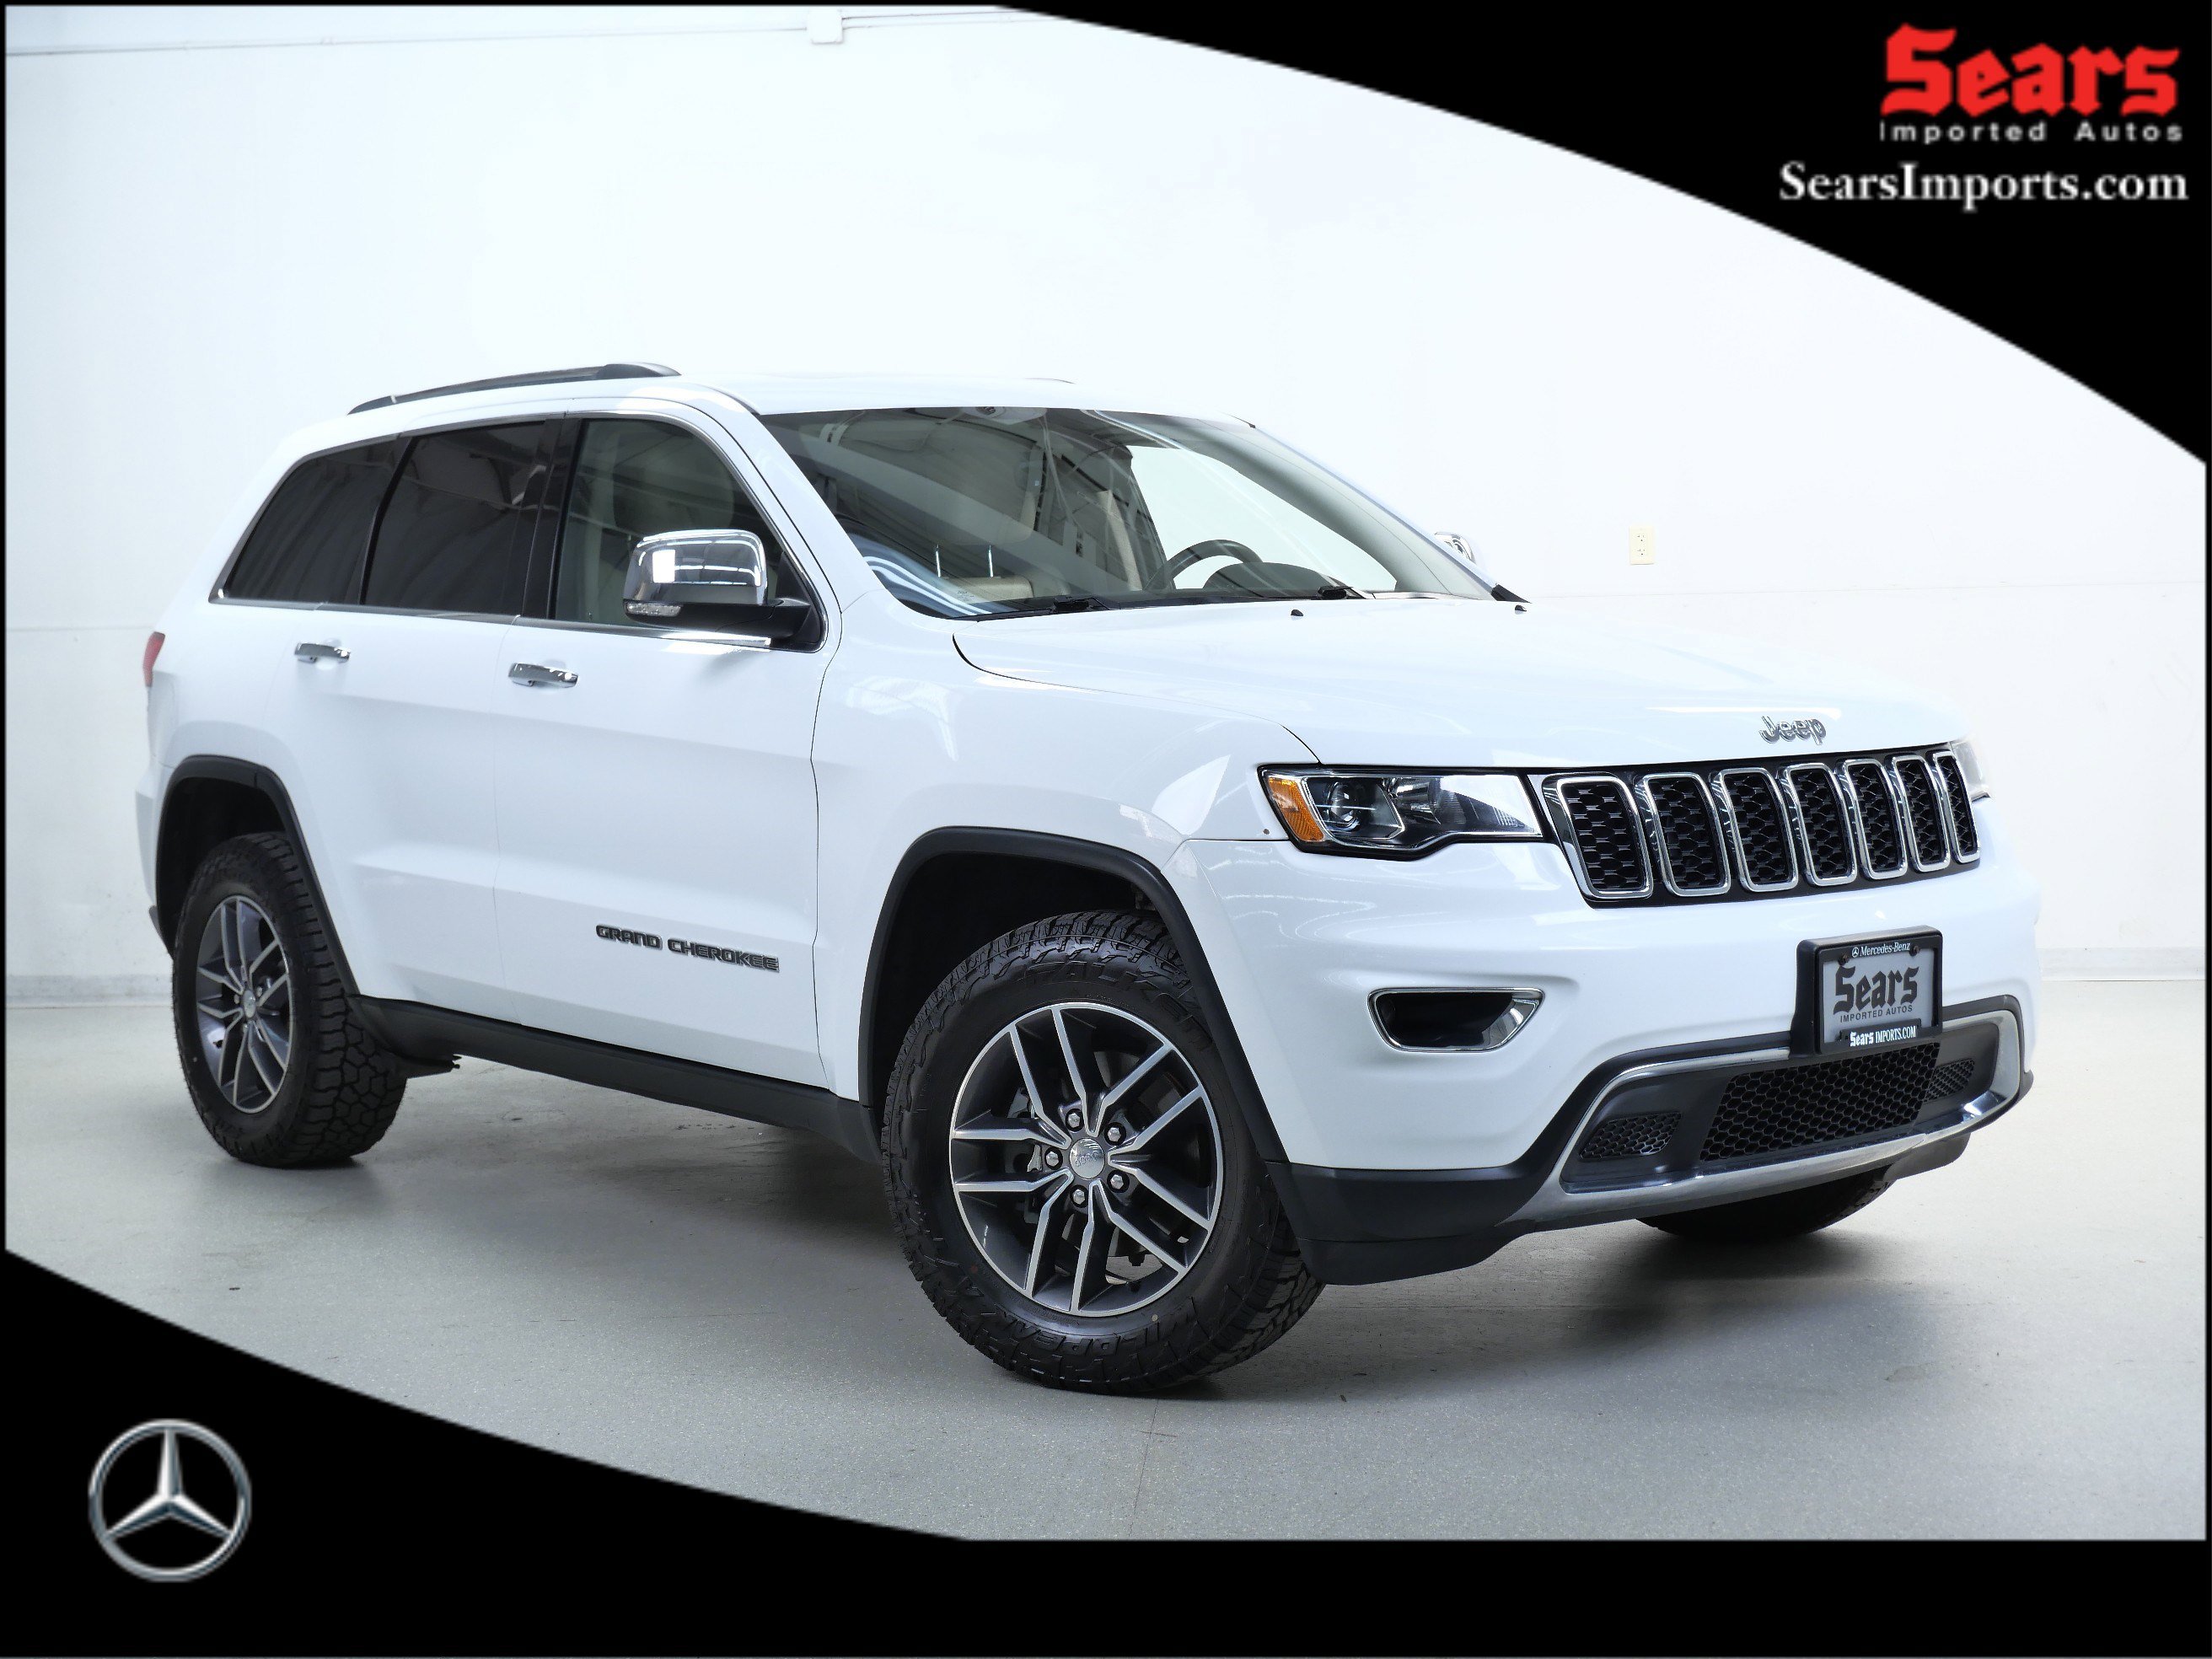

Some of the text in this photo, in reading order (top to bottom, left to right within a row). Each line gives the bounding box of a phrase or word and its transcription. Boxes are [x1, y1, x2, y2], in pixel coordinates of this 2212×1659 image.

[1758, 715, 1827, 746] Jeep
[595, 923, 780, 974] GRAND CHEROKEE
[1860, 942, 1911, 957] Mercedes-Benz
[1833, 965, 1919, 1015] Sears
[1839, 1004, 1913, 1023] IMPORTED AUTOS
[1850, 1025, 1916, 1047] Sears IMPORTS.COM
